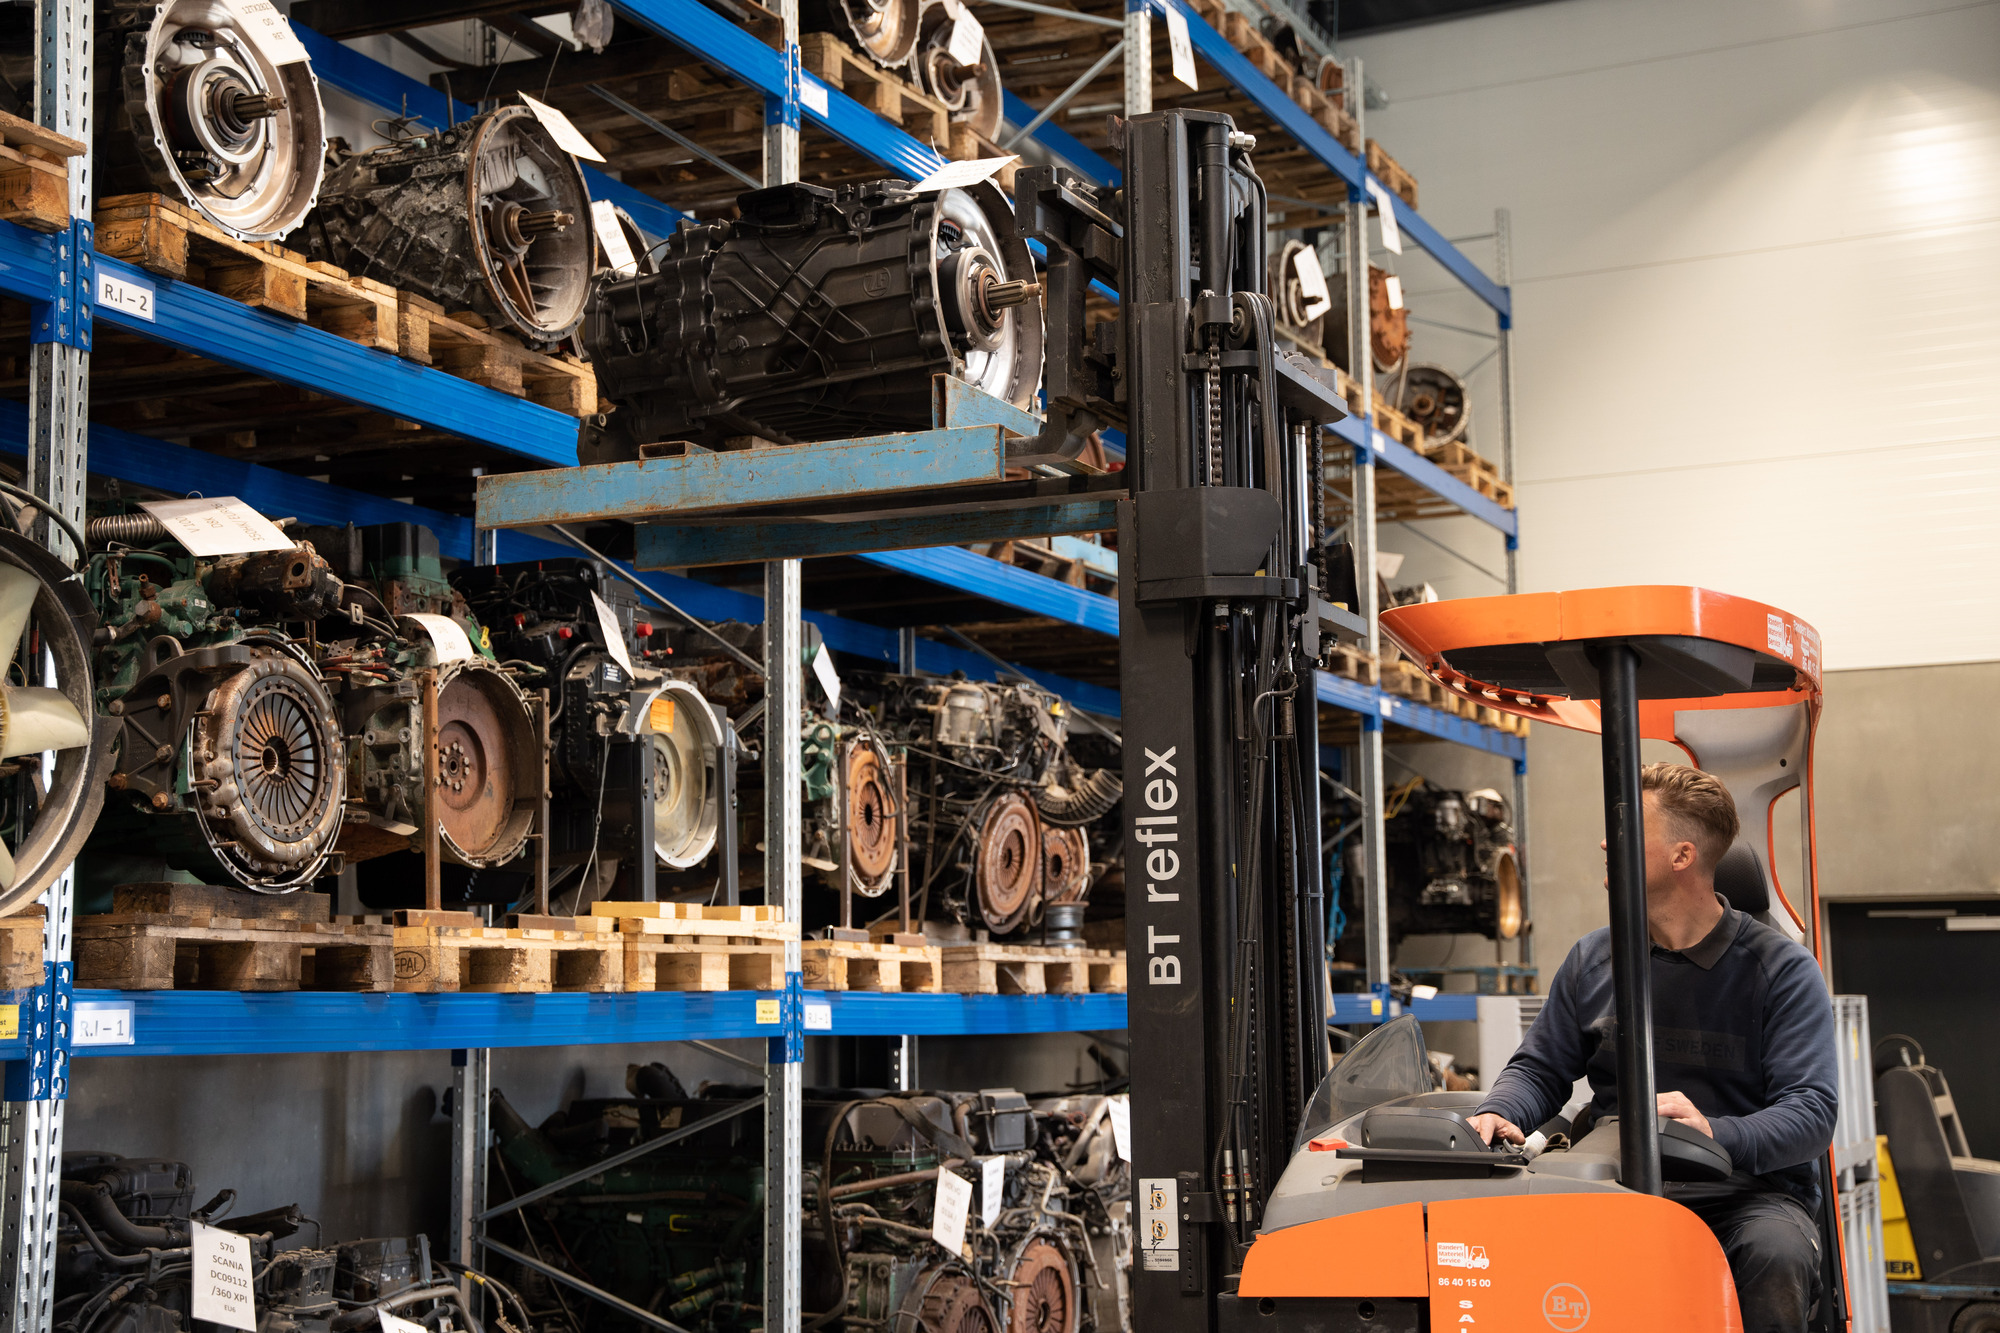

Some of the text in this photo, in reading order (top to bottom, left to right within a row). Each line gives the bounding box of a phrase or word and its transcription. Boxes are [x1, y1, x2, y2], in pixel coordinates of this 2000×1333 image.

[1134, 745, 1182, 985] BT reflex
[802, 965, 819, 976] PAL
[1665, 1038, 1736, 1060] SWEDEN
[219, 1241, 235, 1254] S70
[212, 1254, 244, 1272] SCANIA
[210, 1269, 248, 1288] DC09112
[1438, 1278, 1491, 1287] 86 40 15 00
[211, 1285, 248, 1304] /360 XPI
